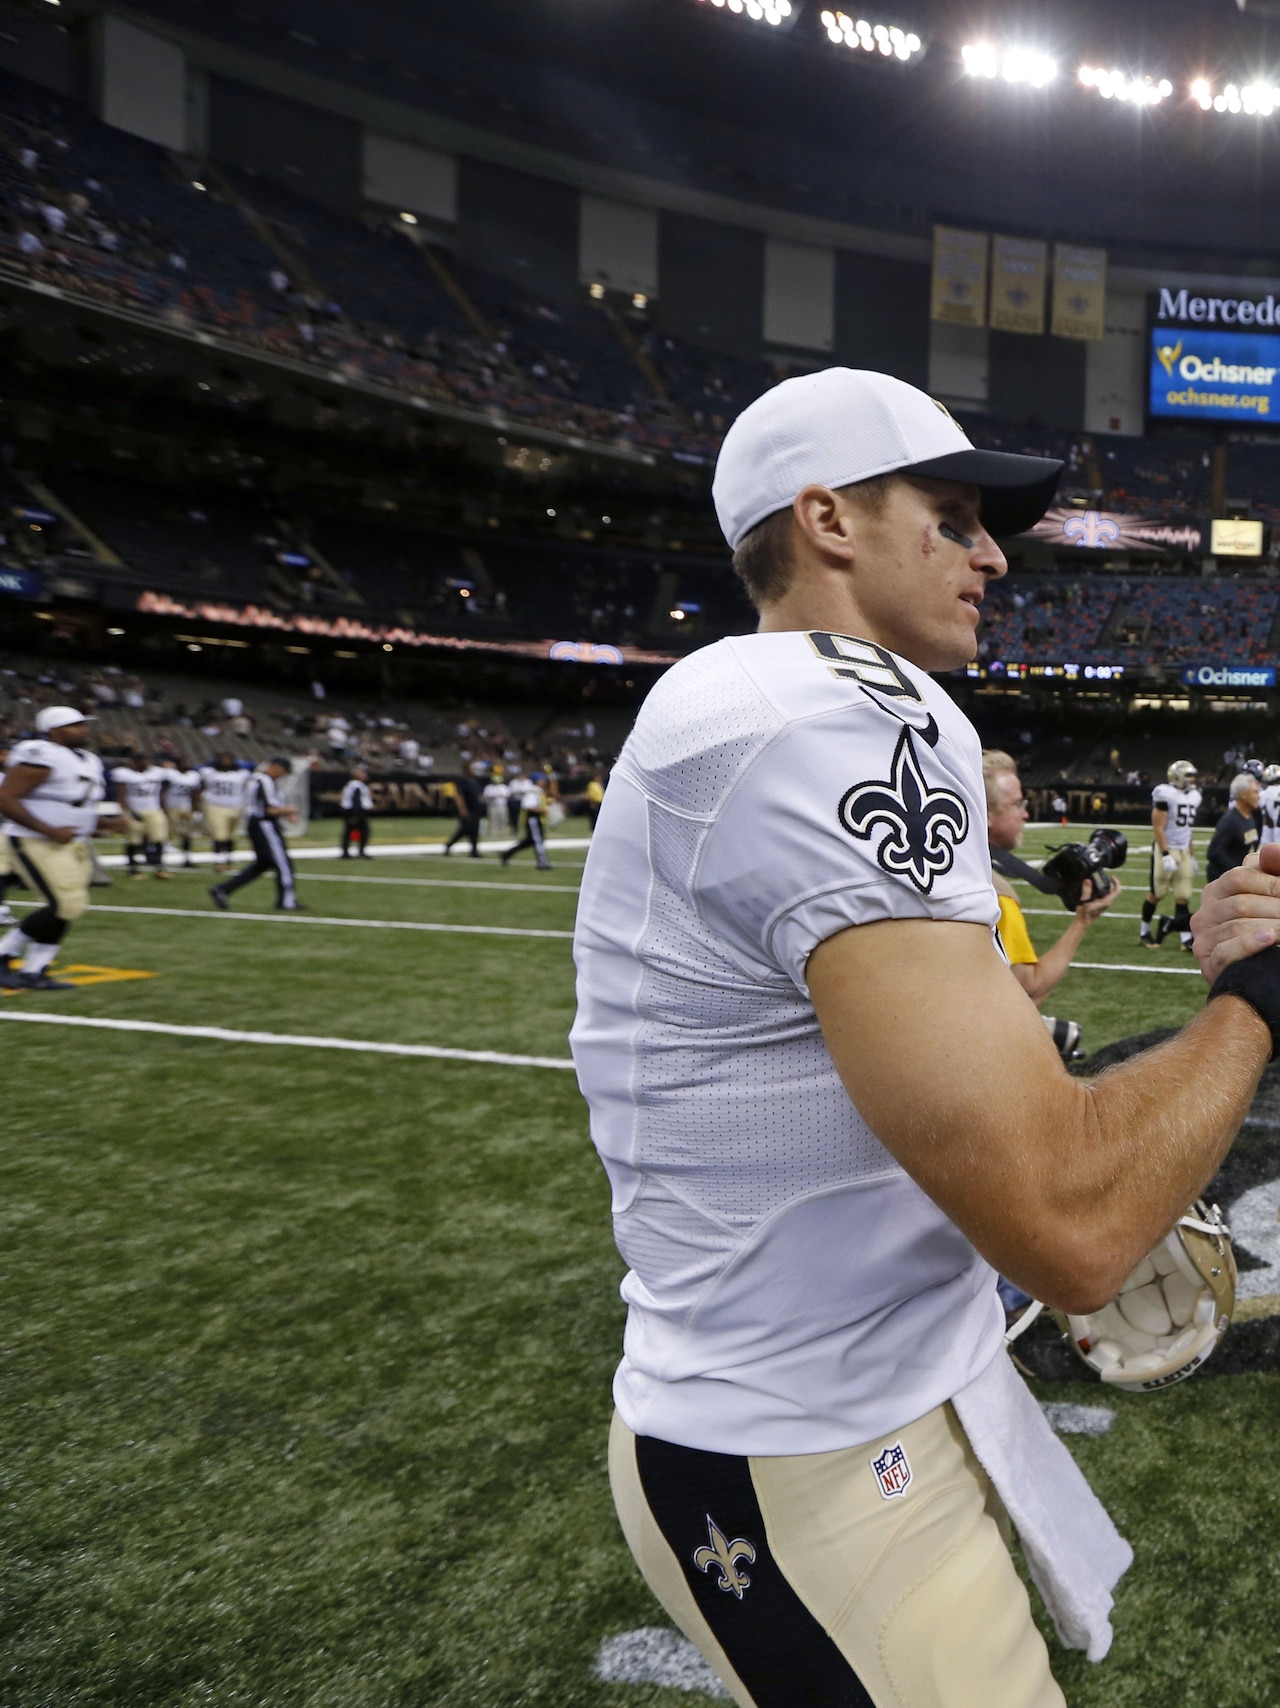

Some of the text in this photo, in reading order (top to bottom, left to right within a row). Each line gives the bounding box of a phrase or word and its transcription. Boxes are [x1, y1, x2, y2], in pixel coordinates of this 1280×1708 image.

[1179, 355, 1278, 385] Ochsner
[1166, 386, 1270, 414] ochsner.org
[802, 630, 928, 706] 9
[1198, 666, 1269, 686] Ochsner
[1142, 1356, 1201, 1390] SAINTS
[881, 1464, 908, 1492] NFL
